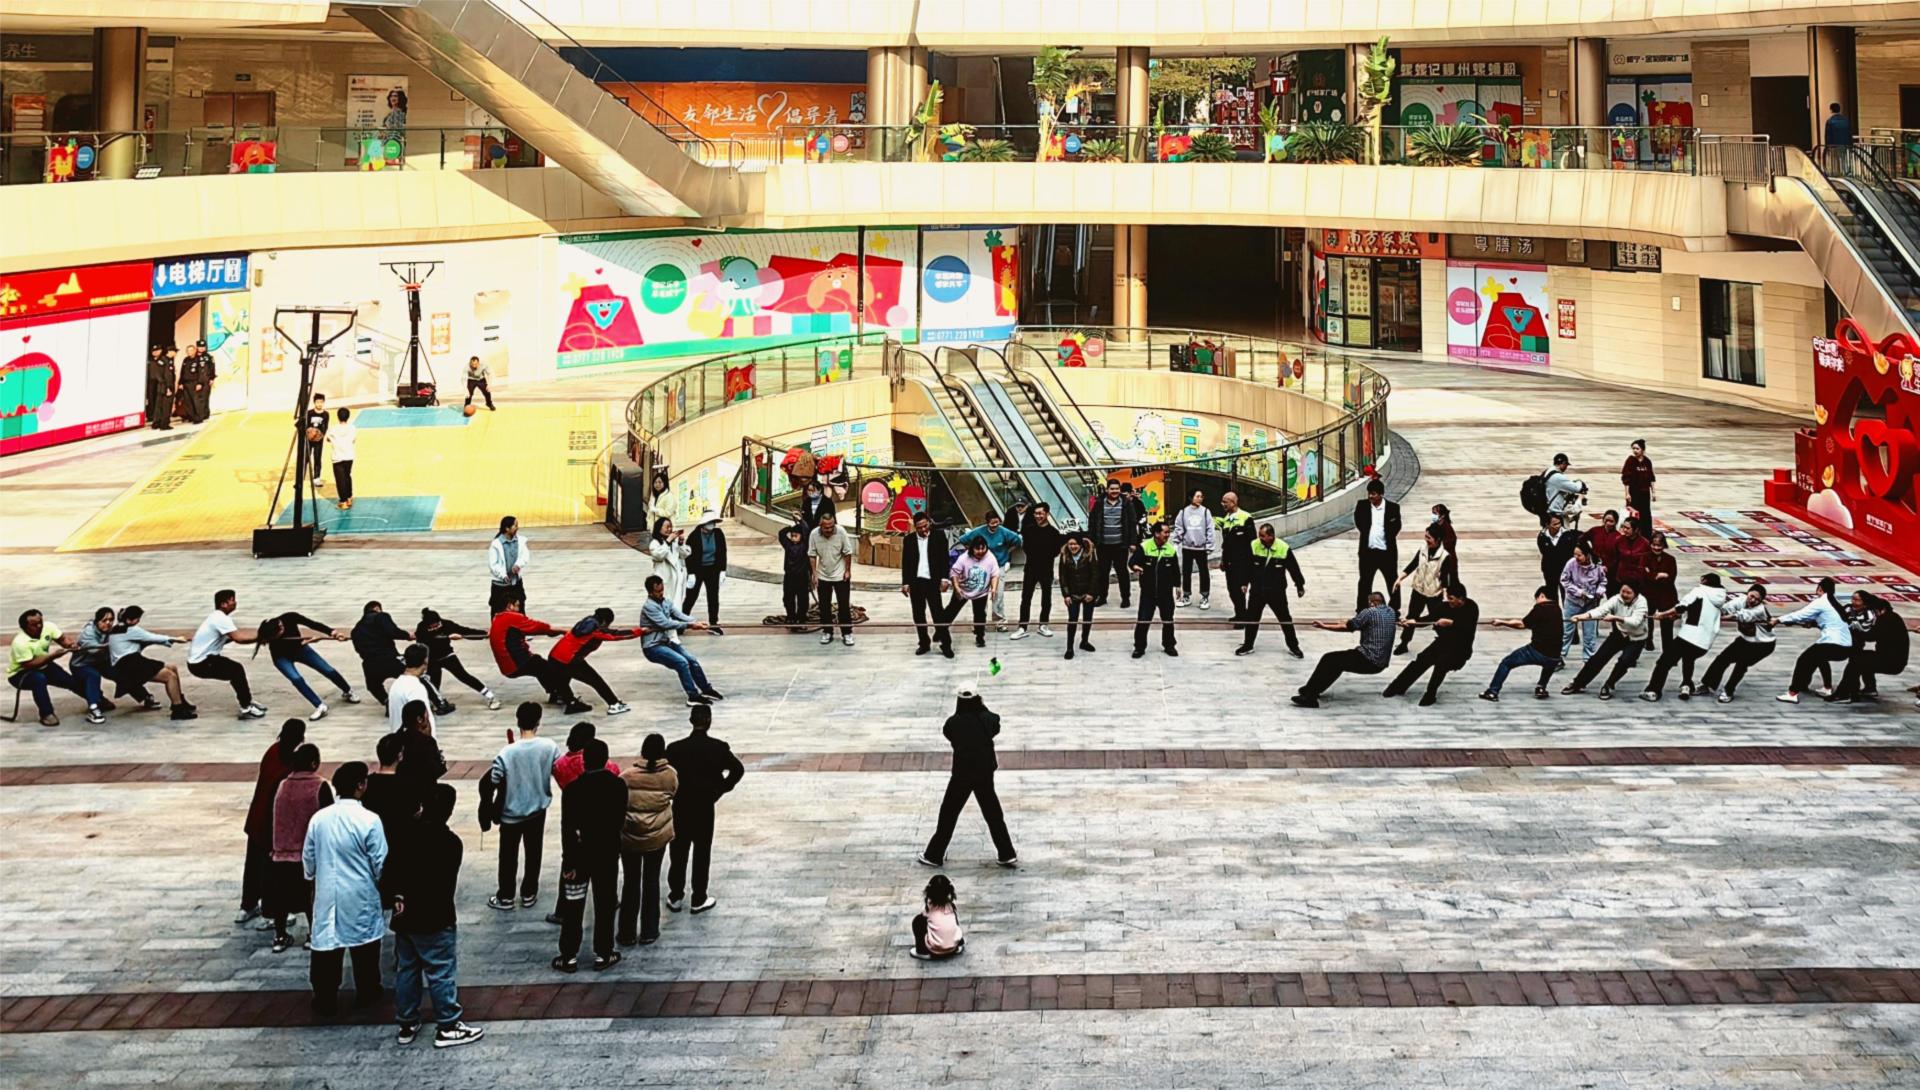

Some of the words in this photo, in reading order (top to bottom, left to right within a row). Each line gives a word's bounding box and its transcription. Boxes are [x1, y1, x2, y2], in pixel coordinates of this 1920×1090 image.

[5, 43, 37, 59] 养生
[1474, 236, 1533, 254] 粤膳汤
[169, 259, 225, 286] 电梯厅
